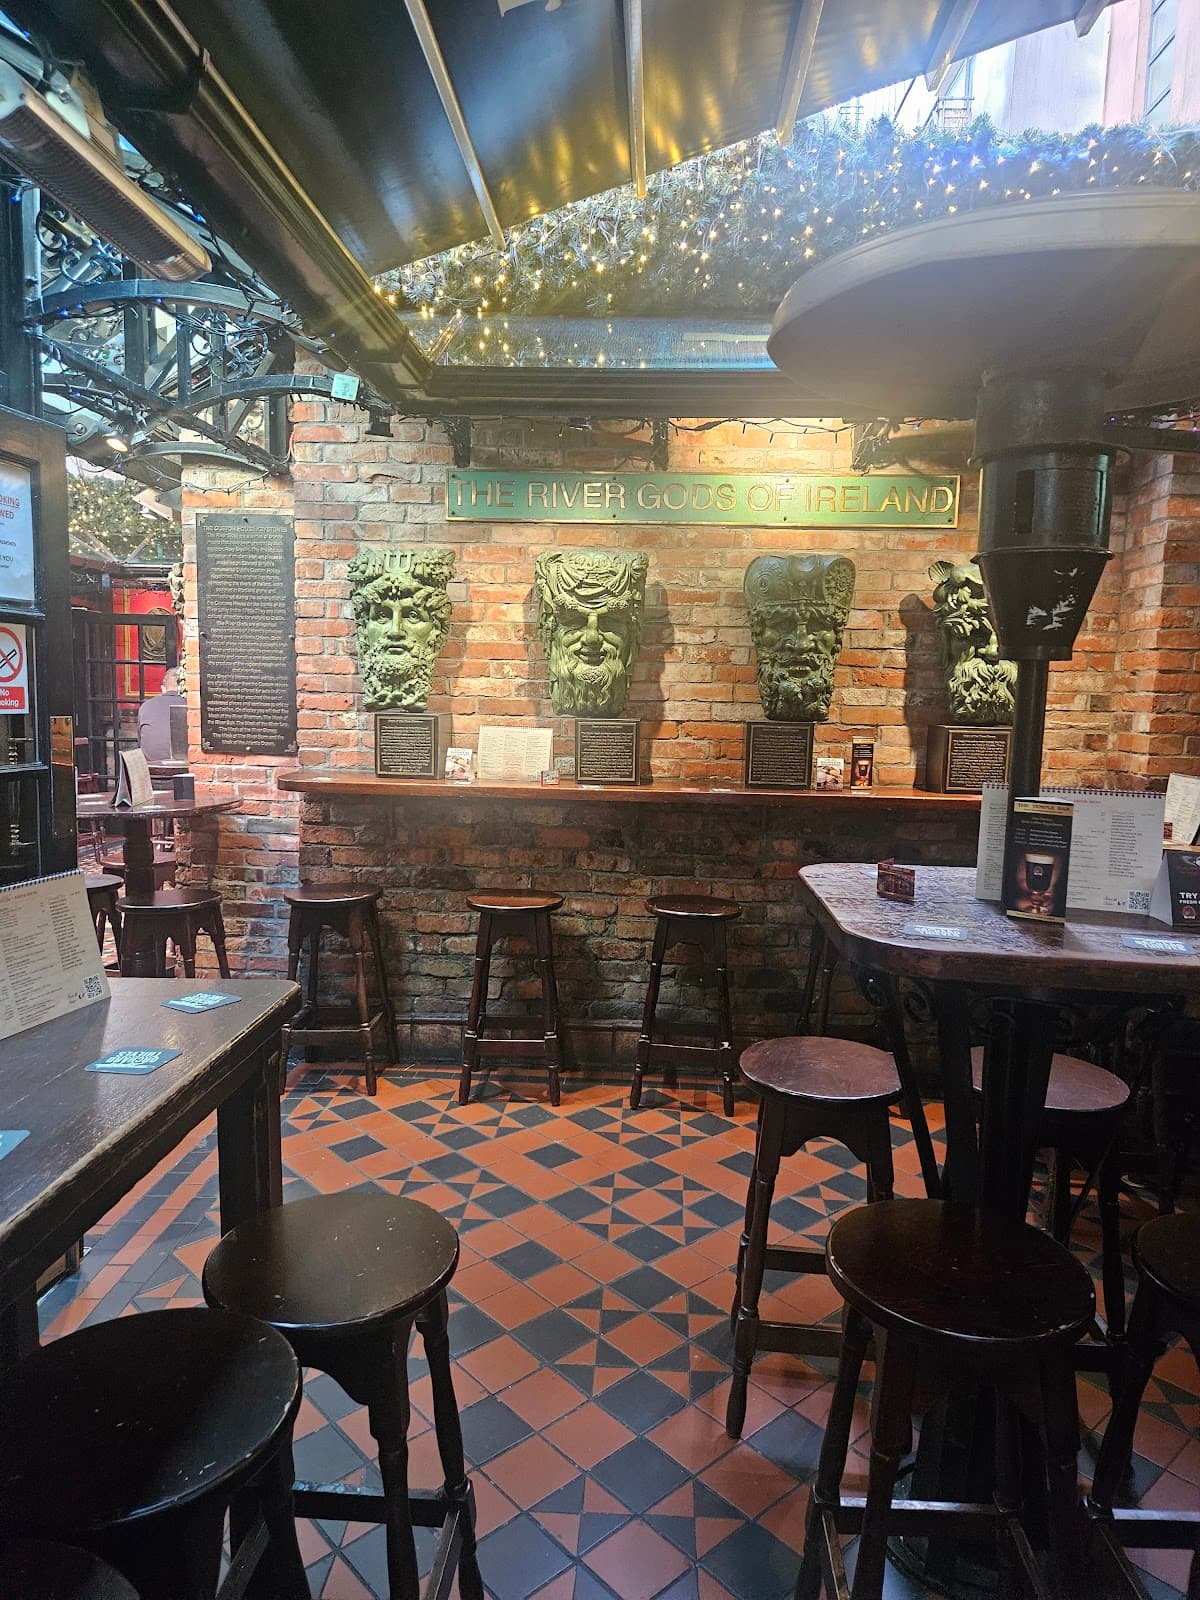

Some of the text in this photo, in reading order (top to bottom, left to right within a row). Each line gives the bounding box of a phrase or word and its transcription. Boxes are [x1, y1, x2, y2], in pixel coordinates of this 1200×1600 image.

[450, 479, 954, 514] THE RIVER GODS OF IRELAND
[1179, 892, 1198, 900] TRY
